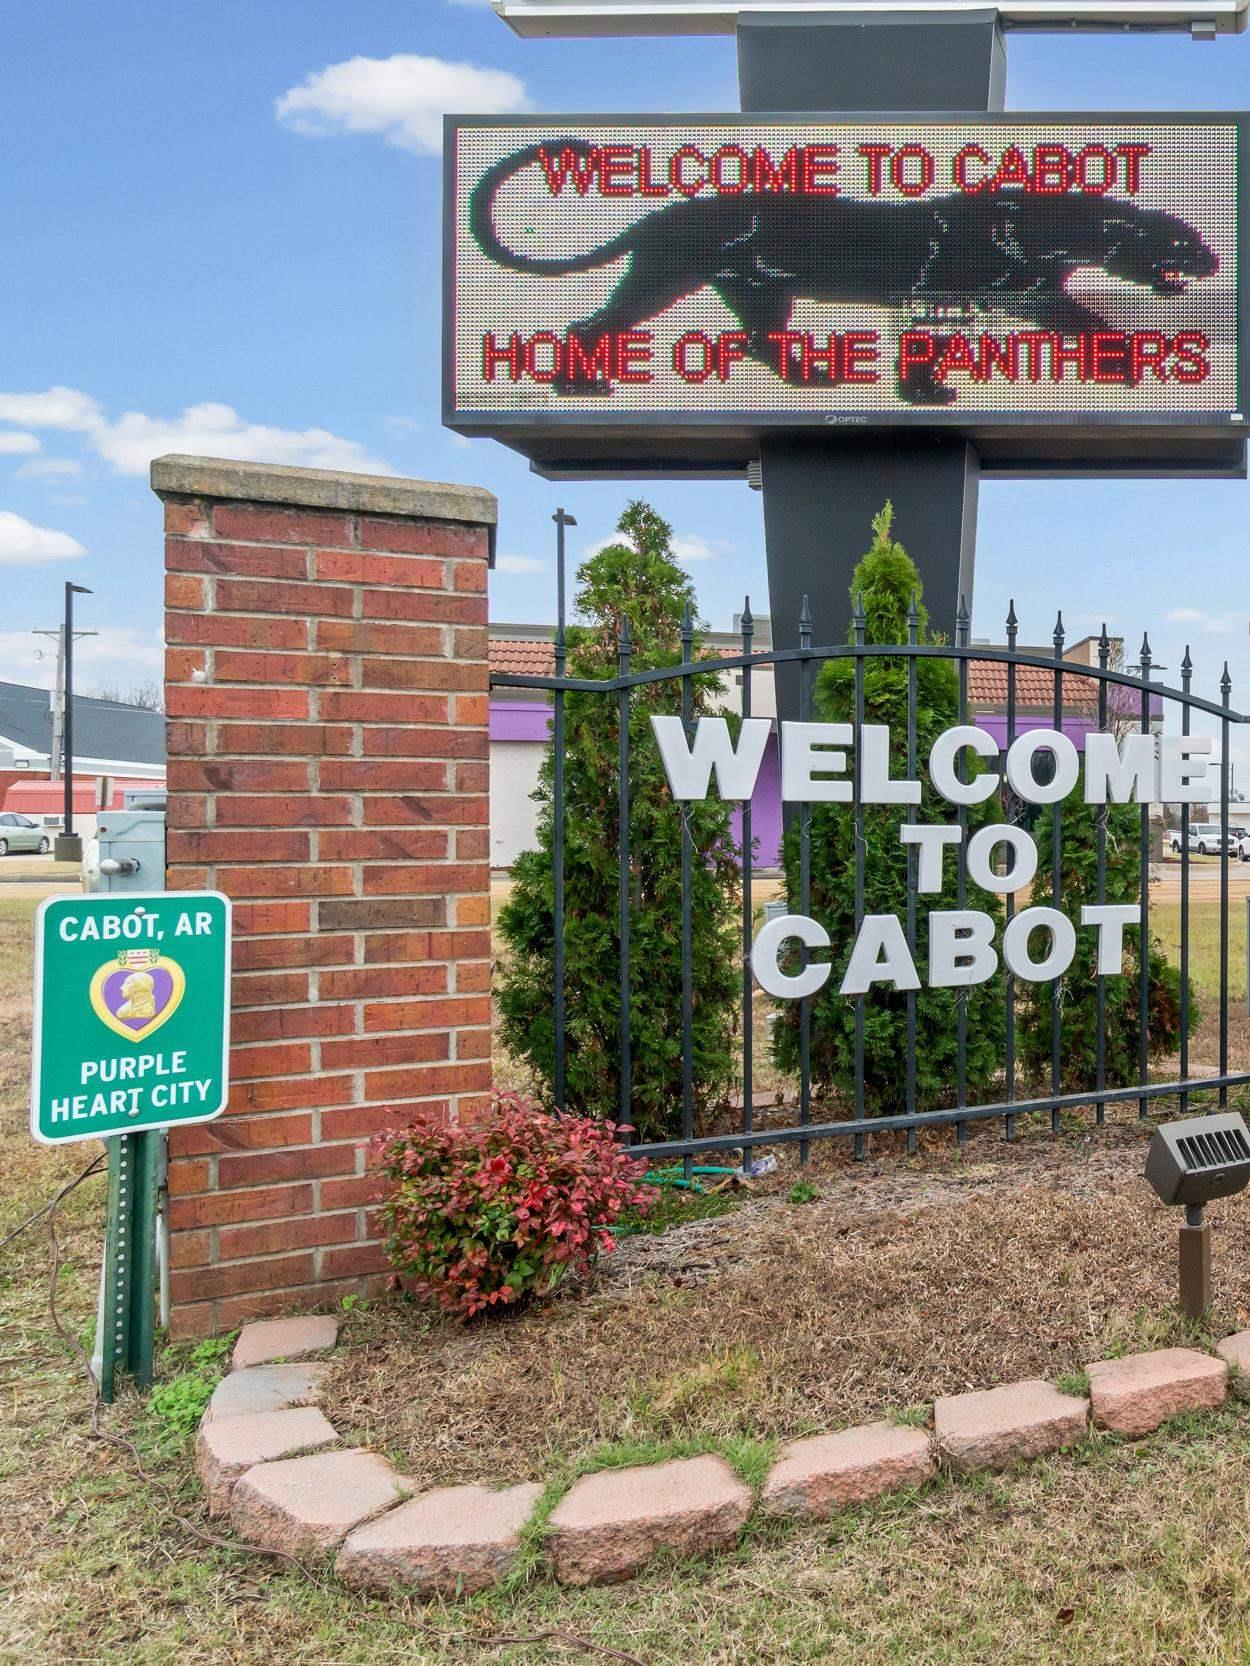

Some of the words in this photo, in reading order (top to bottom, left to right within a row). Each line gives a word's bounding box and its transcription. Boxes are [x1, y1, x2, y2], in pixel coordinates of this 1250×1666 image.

[535, 143, 840, 198] WELCOME
[855, 144, 934, 197] TO
[952, 143, 1152, 197] CABOT
[481, 330, 652, 384] HOME
[672, 331, 753, 384] OF
[769, 331, 881, 384] THE
[898, 330, 1211, 388] PANTHERS
[838, 416, 867, 424] OPTEC
[649, 715, 1213, 805] WELCOME
[900, 823, 1038, 893] TO
[58, 913, 164, 942] CABOT,
[174, 912, 213, 935] AR
[750, 904, 1142, 999] CABOT
[80, 1050, 187, 1085] PURPLE
[51, 1088, 144, 1123] HEART
[151, 1078, 212, 1108] CITY
